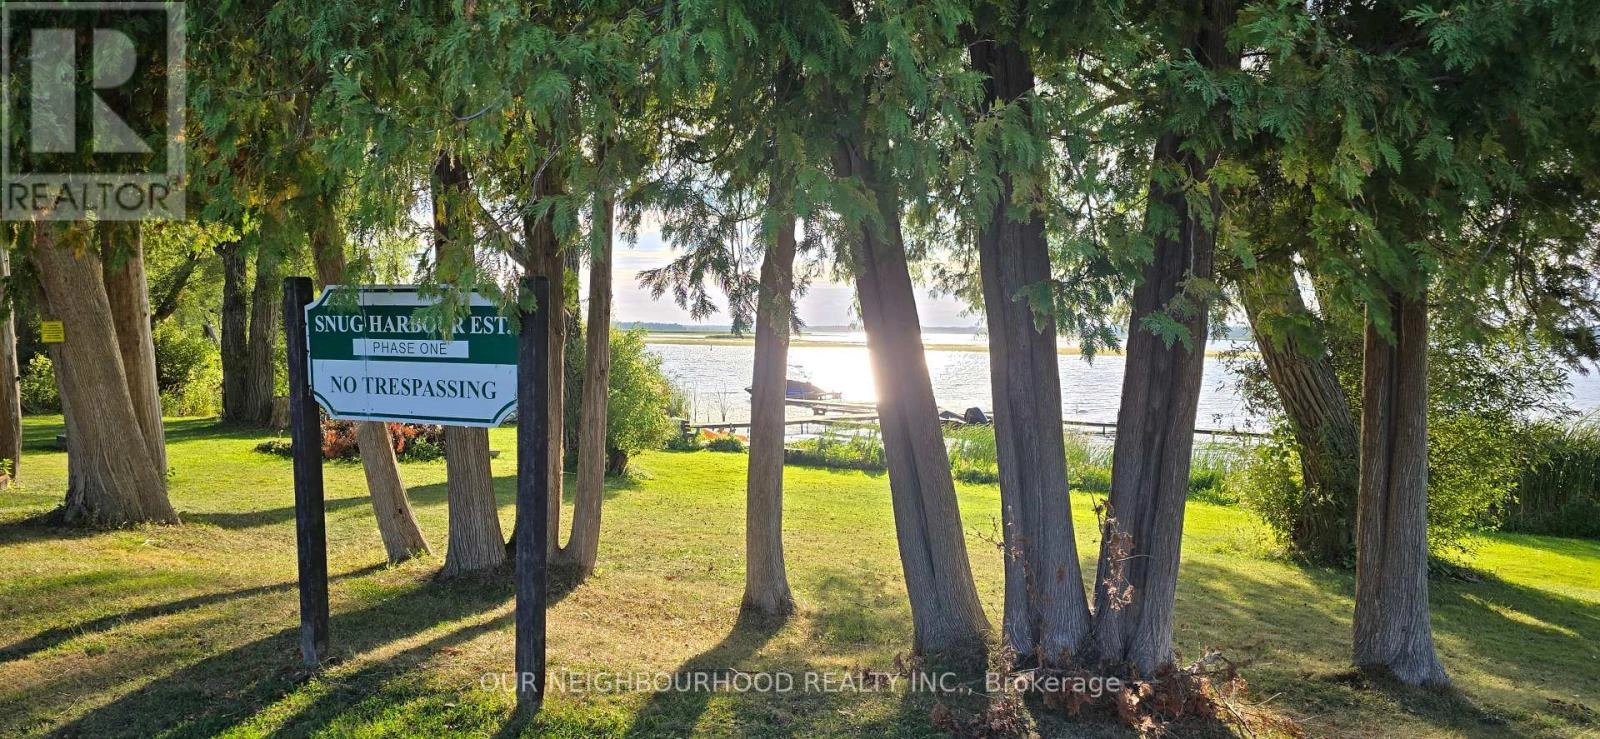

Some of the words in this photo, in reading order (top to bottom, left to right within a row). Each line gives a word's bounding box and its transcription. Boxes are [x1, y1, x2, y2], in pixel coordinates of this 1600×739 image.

[315, 315, 365, 333] SNUG
[470, 316, 511, 335] EST.
[373, 341, 415, 354] PHASE
[420, 342, 447, 355] ONE
[331, 375, 357, 394] NO
[362, 376, 497, 400] TRESPASSING
